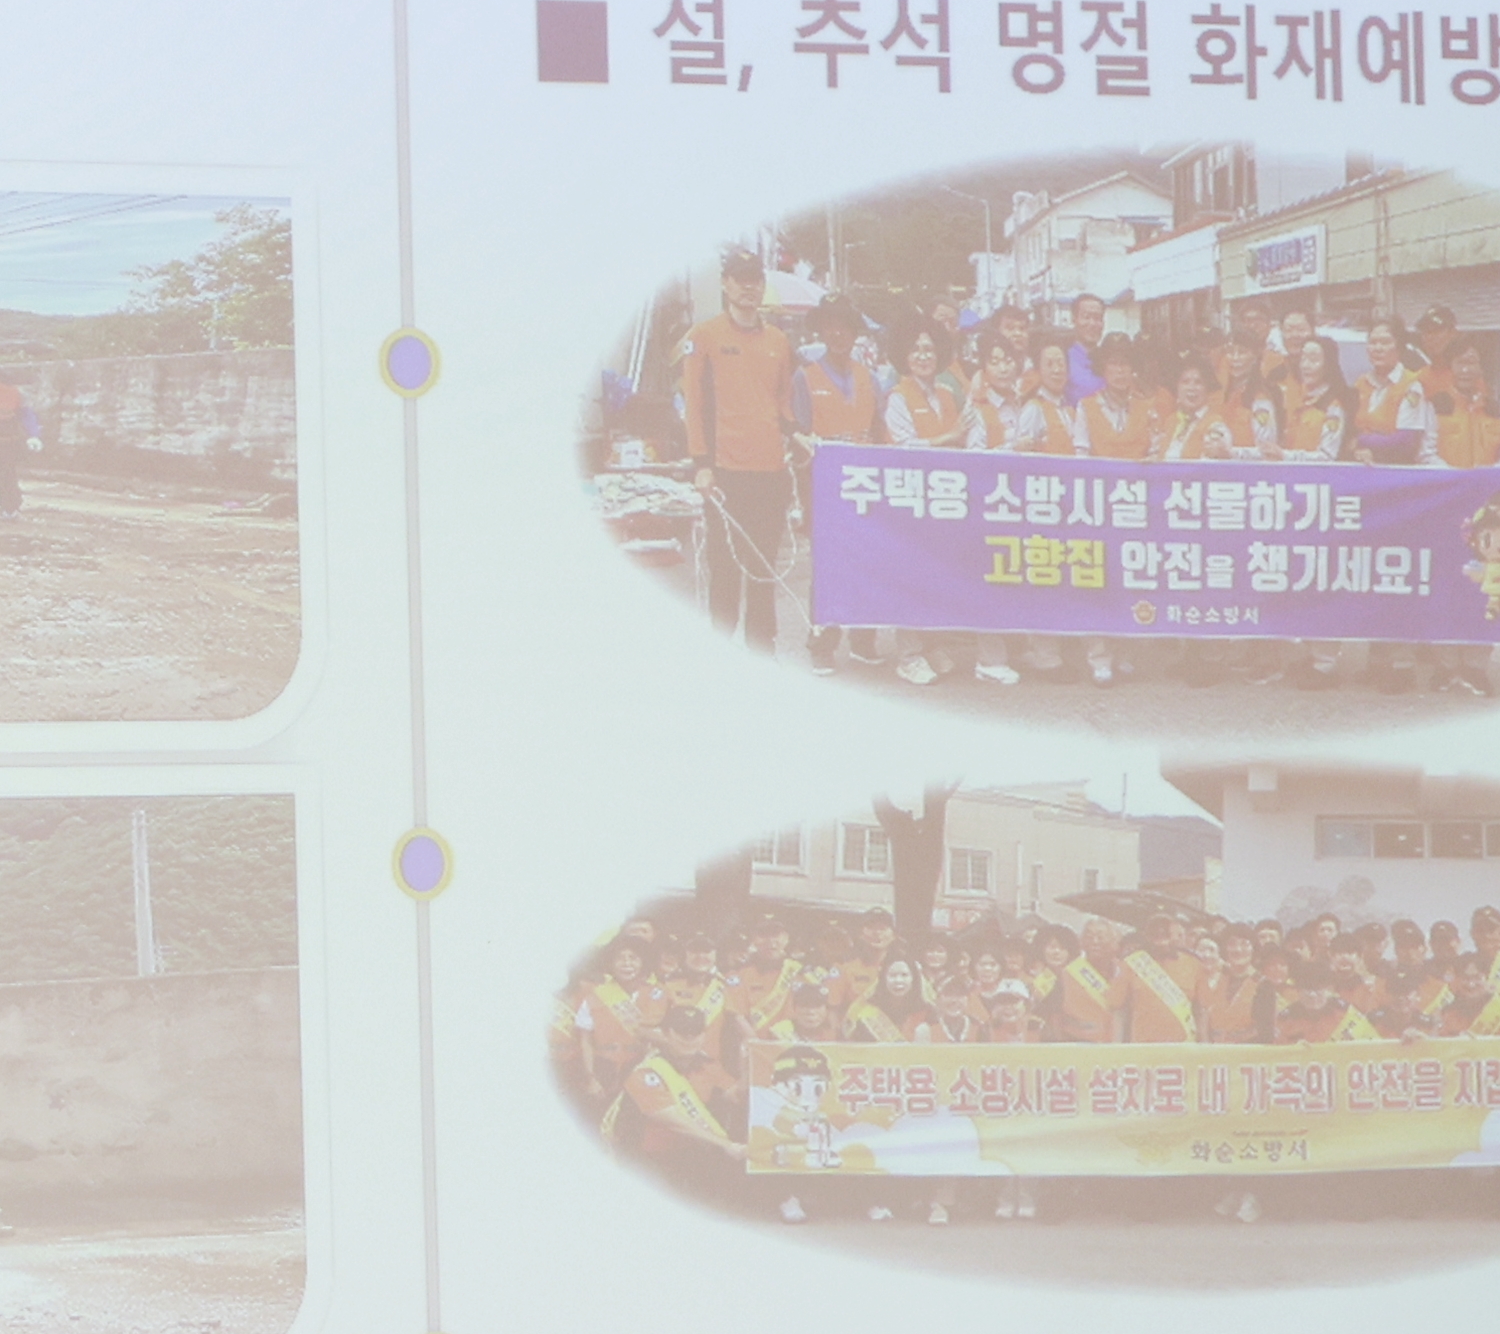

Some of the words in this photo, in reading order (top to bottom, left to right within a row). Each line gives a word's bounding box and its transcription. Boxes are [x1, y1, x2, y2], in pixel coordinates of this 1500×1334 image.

[998, 0, 1151, 97] 명절
[840, 464, 968, 519] 주택용
[983, 470, 1148, 529] 소방시설
[1163, 475, 1362, 533] 선물하기로
[983, 533, 1106, 589] 고향집
[1120, 539, 1235, 593] 안전을
[1246, 541, 1432, 597] 챙기세요!
[1166, 603, 1262, 627] 화순소방서
[838, 1064, 938, 1117] 주택용
[948, 1063, 1078, 1115] 소방시설
[1088, 1061, 1188, 1115] 설치로
[1196, 1063, 1228, 1113] 내
[1346, 1057, 1444, 1111] 안전을
[1190, 1139, 1308, 1163] 화순소방서
